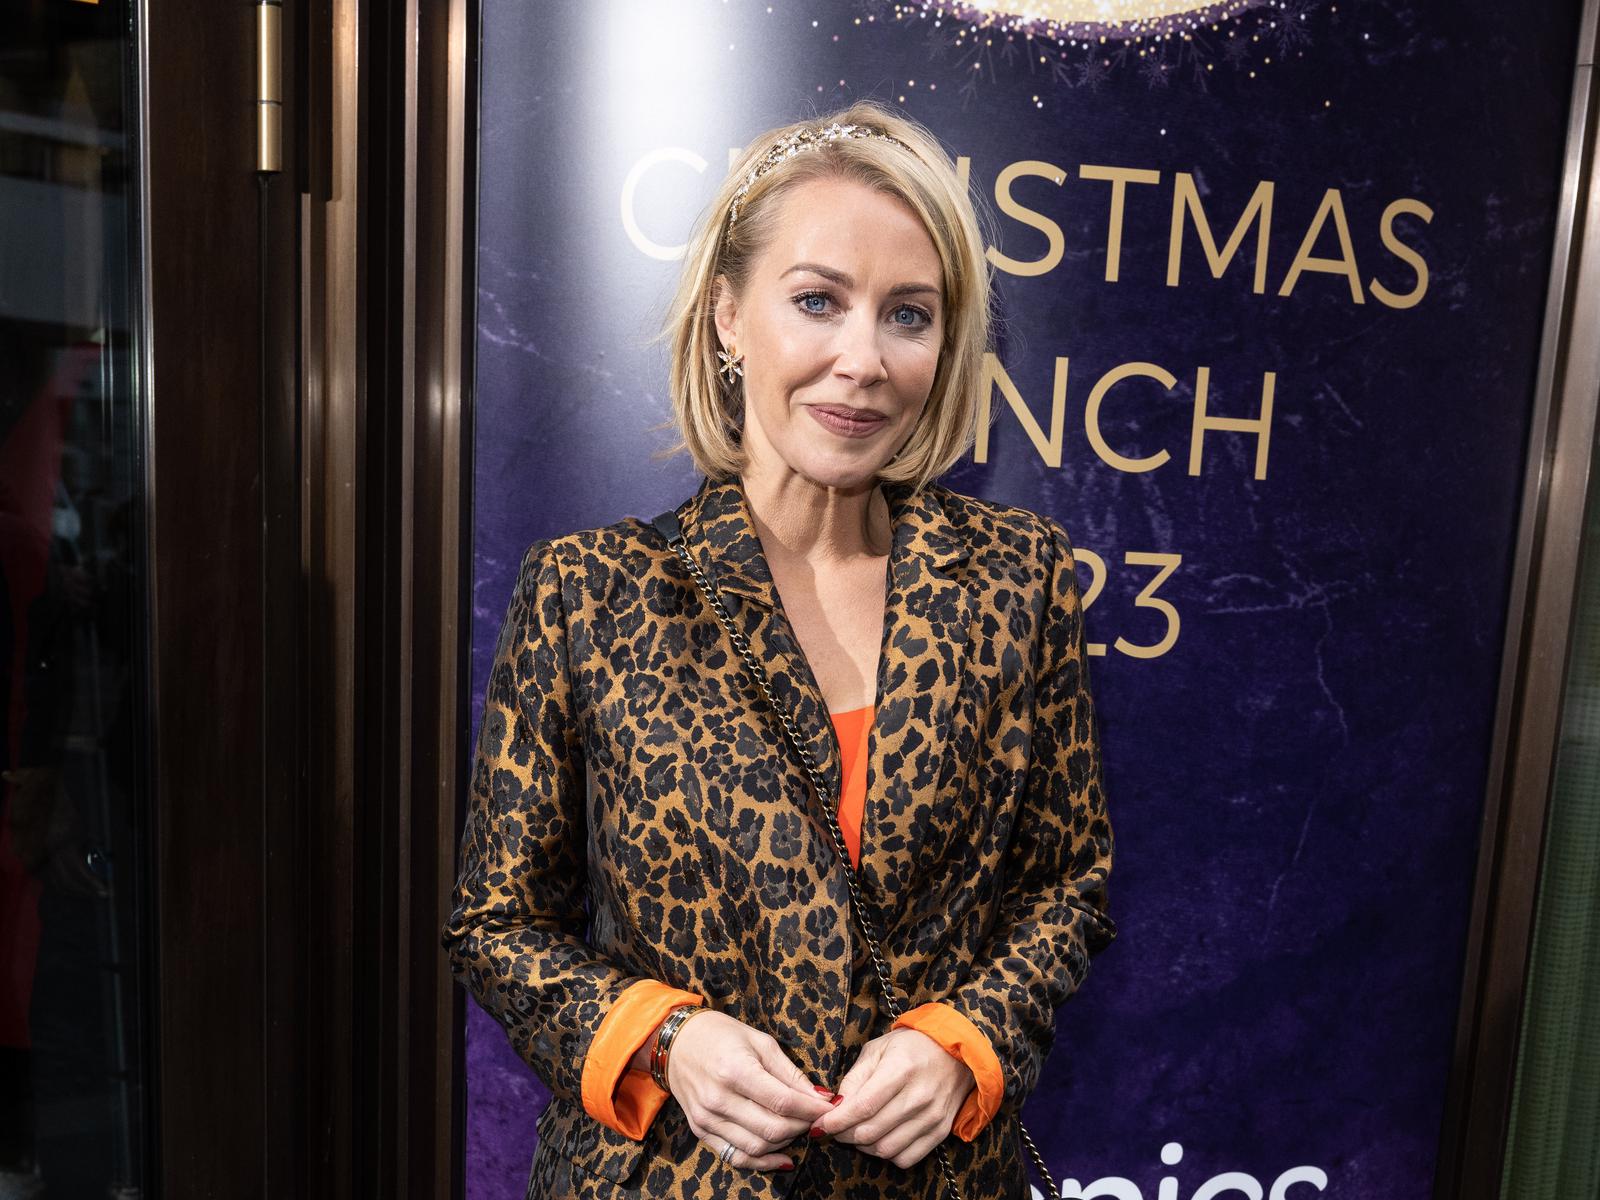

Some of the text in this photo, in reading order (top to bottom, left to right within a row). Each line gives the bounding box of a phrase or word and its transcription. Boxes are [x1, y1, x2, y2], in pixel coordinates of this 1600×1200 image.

[620, 147, 1434, 309] CSTMAS
[973, 352, 1276, 481] NCH
[1072, 548, 1182, 659] 23
